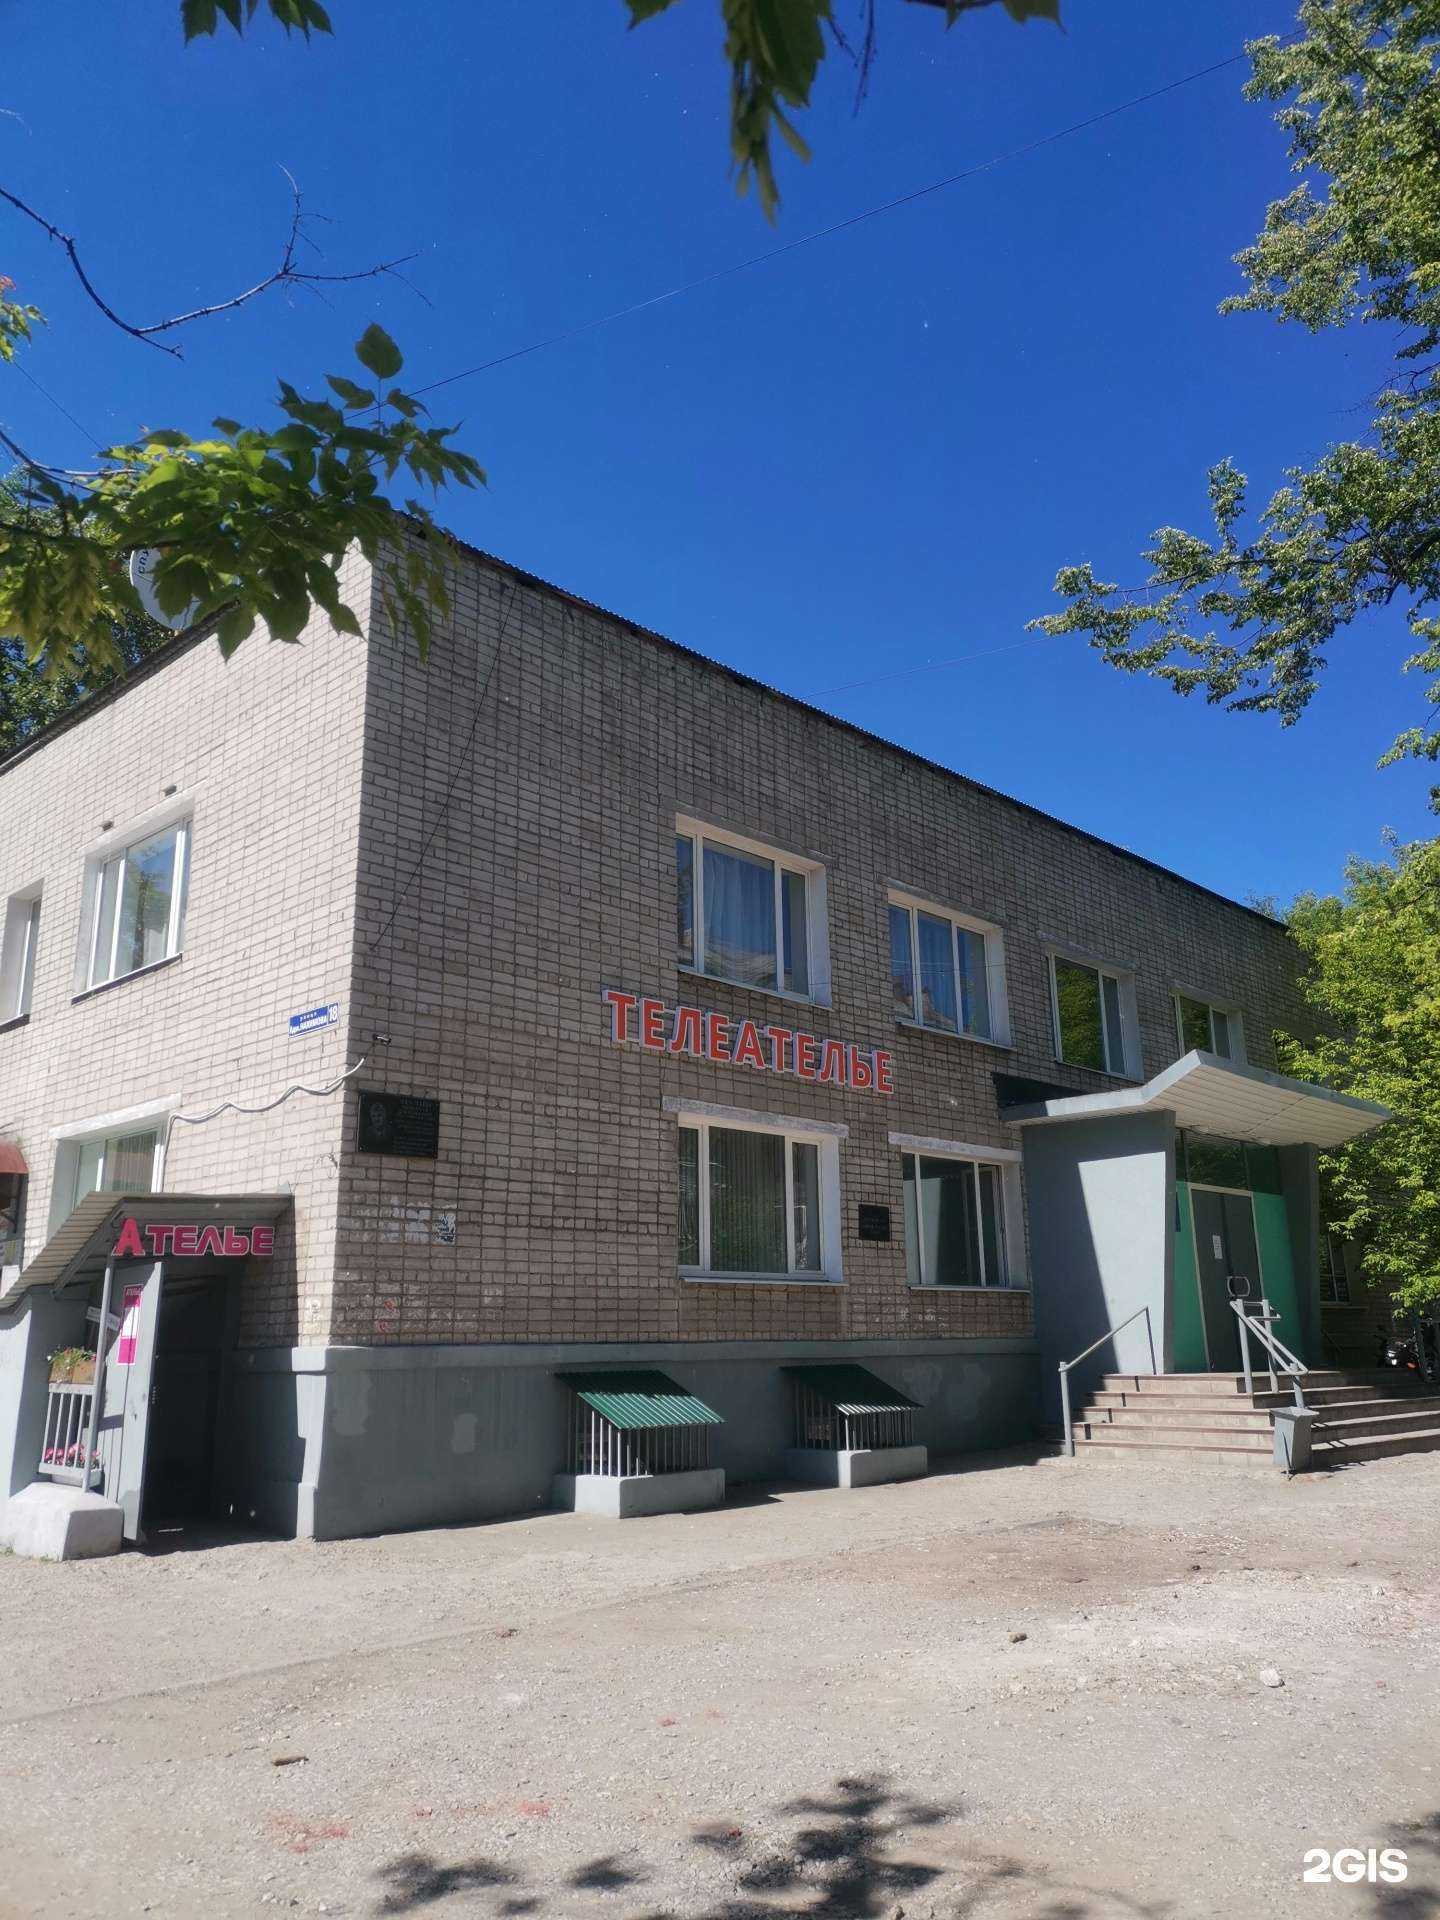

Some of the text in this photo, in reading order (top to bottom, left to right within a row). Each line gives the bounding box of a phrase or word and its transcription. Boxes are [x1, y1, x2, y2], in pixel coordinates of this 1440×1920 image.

[329, 1005, 338, 1021] 18
[603, 990, 894, 1094] ТЕЛЕАТЕЛЬЕ
[112, 1218, 274, 1255] АТЕЛЬЕ
